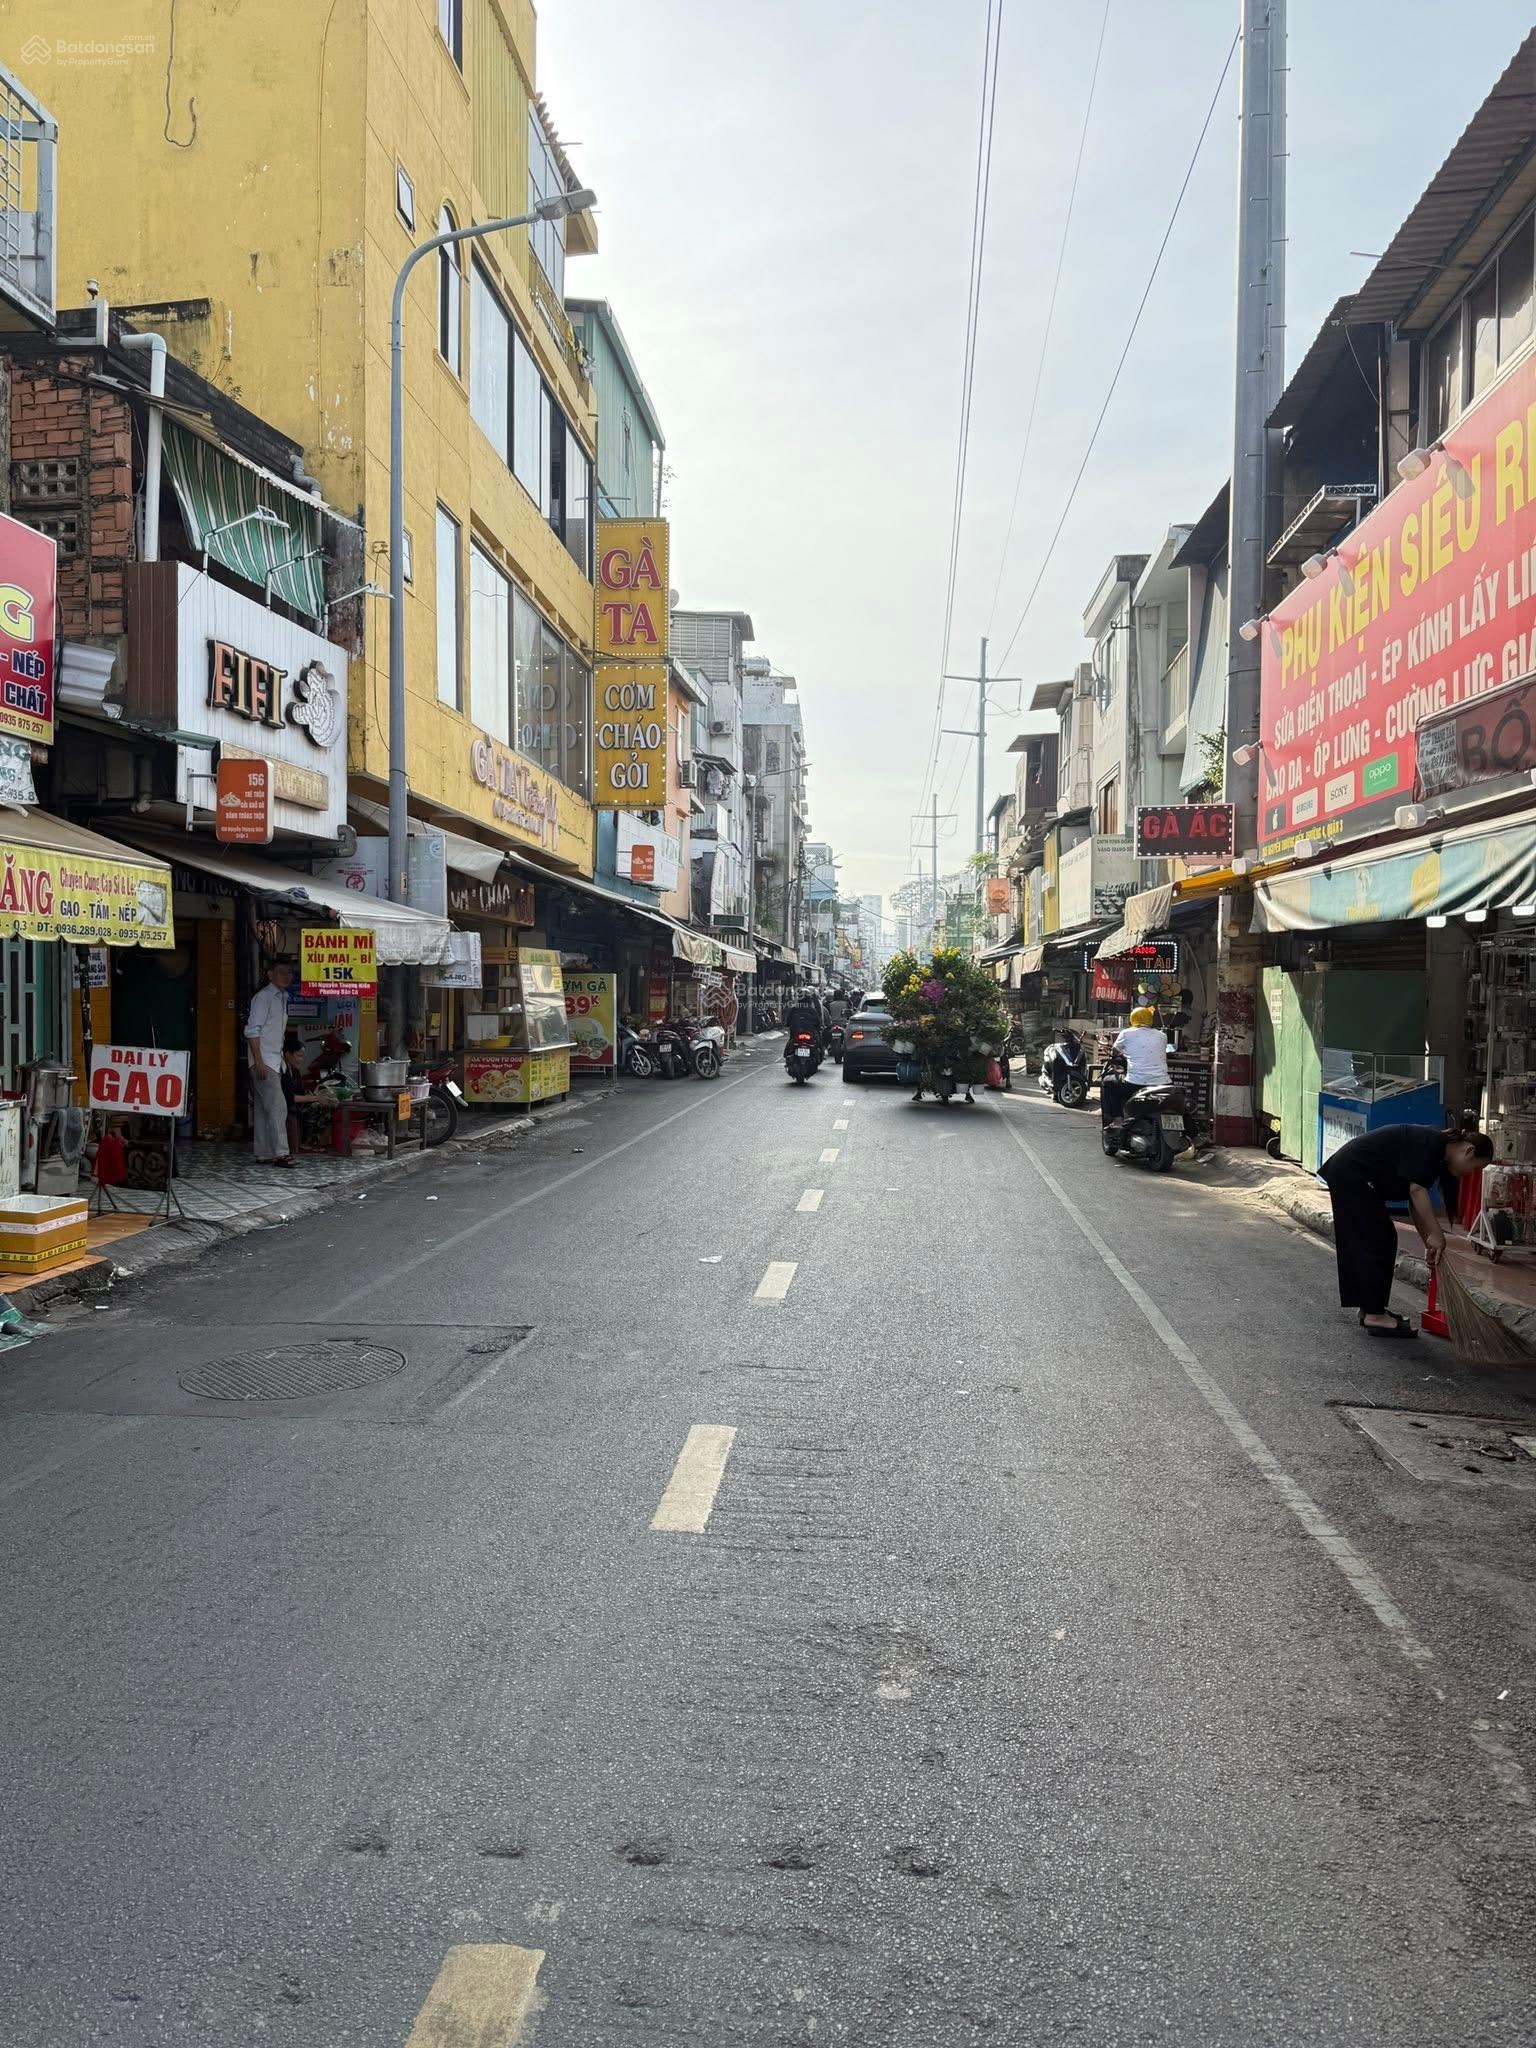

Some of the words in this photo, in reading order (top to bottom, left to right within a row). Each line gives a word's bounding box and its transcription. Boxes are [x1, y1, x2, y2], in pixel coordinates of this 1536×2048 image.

[600, 535, 662, 590] GÀ
[601, 602, 659, 645] TA
[1281, 599, 1322, 690] PHỤ
[1329, 535, 1390, 655] KIỆN
[12, 650, 46, 680] NẾP
[1274, 705, 1295, 750] SỬA
[1297, 690, 1325, 737] ĐIỆN
[1328, 660, 1367, 717] THOẠI
[1381, 637, 1402, 685] ÉP
[1407, 611, 1453, 670] KÍNH
[1459, 561, 1500, 640] LẤY
[4, 681, 48, 716] CHẤT
[206, 639, 289, 729] FIFI
[604, 680, 656, 712] CƠM
[598, 715, 662, 751] CHÁO
[609, 752, 649, 789] GỎI
[1288, 755, 1303, 792] DA
[1313, 732, 1330, 779] ỐP
[1333, 719, 1371, 770] LƯNG
[248, 773, 265, 786] 156
[1330, 783, 1349, 801] SONY
[1142, 810, 1181, 840] GÀ
[1189, 808, 1227, 838] ÁC
[60, 867, 83, 891] Chuyên
[84, 871, 100, 895] Cung
[13, 919, 28, 932] Q.3
[37, 922, 54, 933] ĐT:
[60, 900, 80, 921] GẠO
[88, 899, 110, 920] TẤM
[118, 902, 137, 923] NẾP
[304, 932, 348, 949] BÁNH
[307, 950, 325, 964] XÍU
[327, 953, 350, 966] MẠI
[322, 967, 354, 980] 15K
[587, 977, 608, 992] GÀ
[148, 1052, 169, 1068] LÝ
[92, 1067, 183, 1111] GẠO
